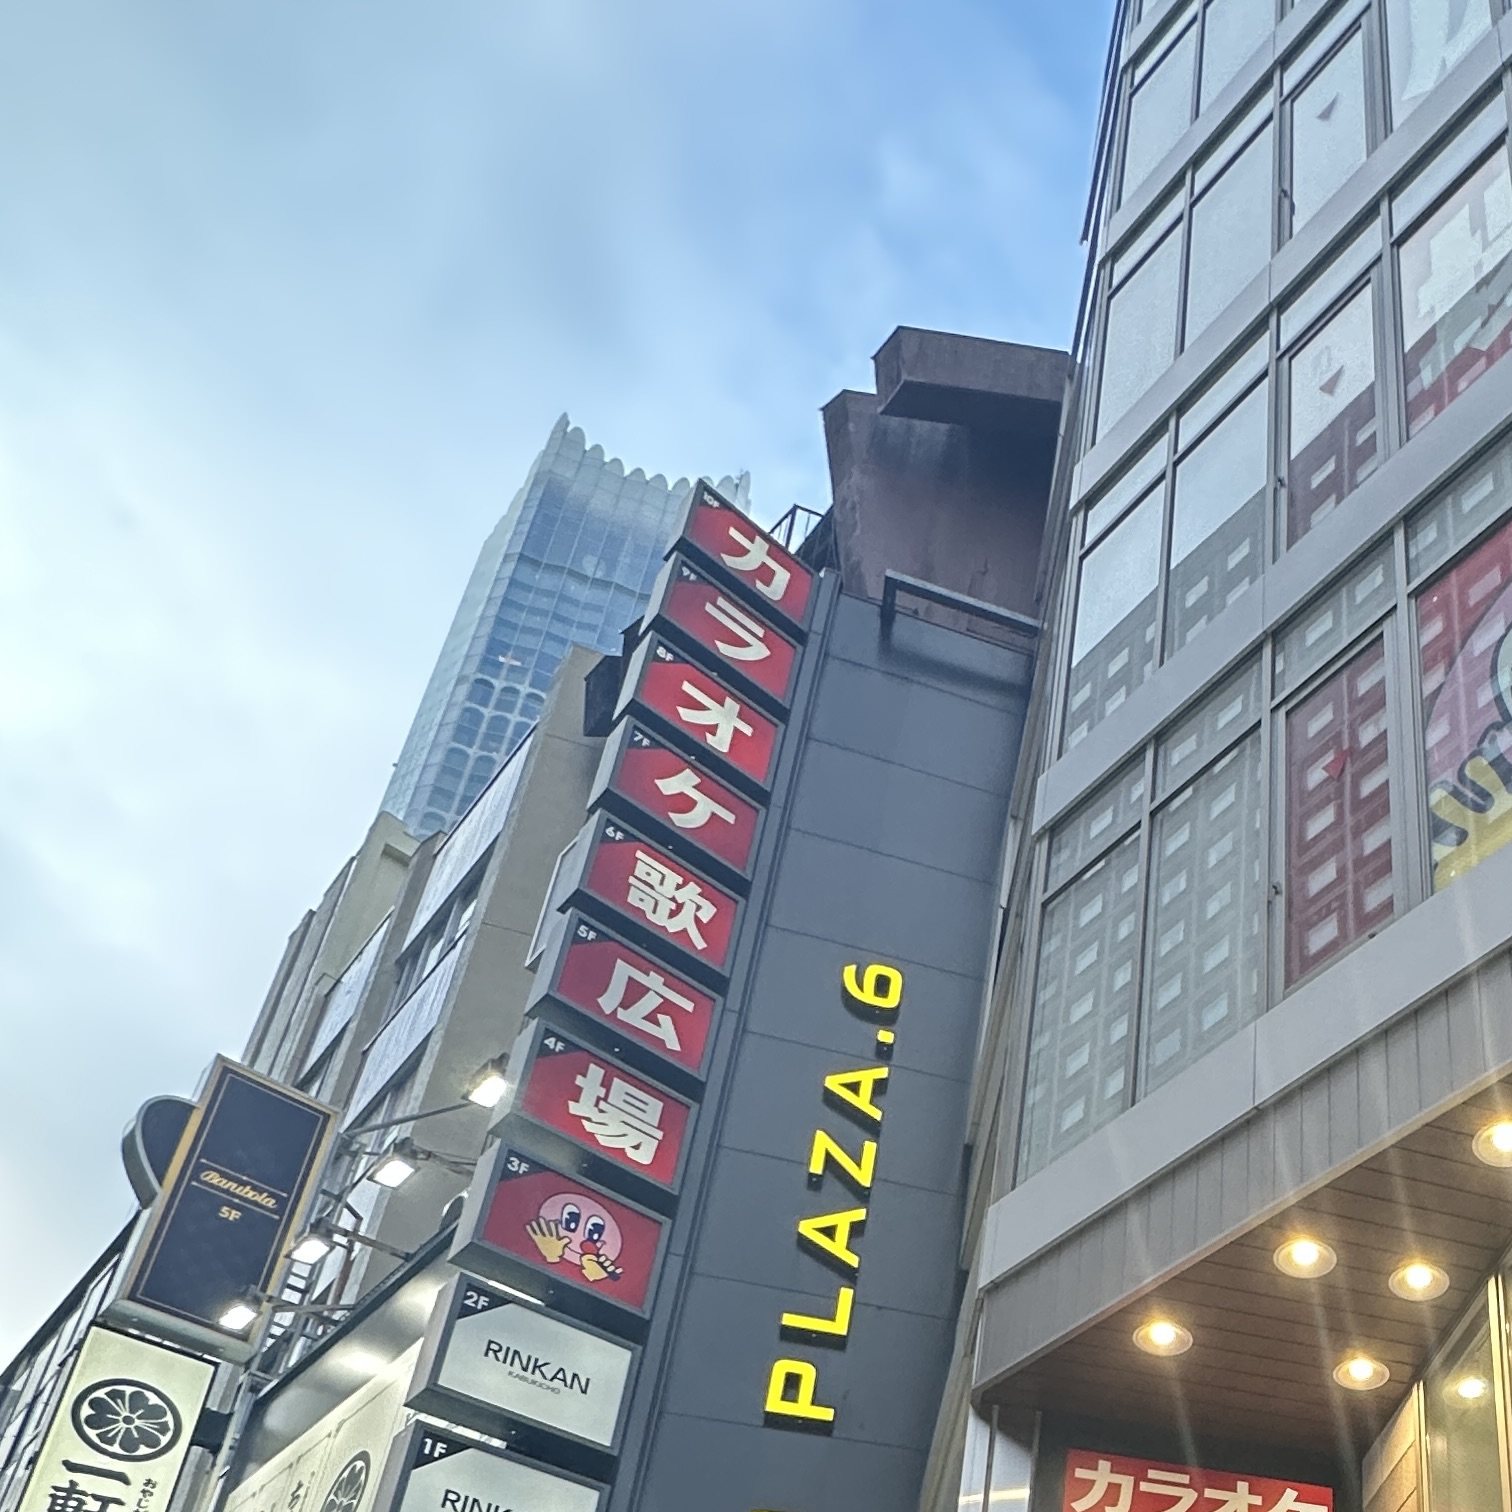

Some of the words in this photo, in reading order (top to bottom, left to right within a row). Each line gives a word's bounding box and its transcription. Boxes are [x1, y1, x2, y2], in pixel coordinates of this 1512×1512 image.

[633, 730, 651, 747] 7F
[605, 826, 625, 842] 6F
[577, 924, 598, 941] 5F
[543, 1036, 566, 1053] 4F
[506, 1157, 530, 1174] 3F
[218, 1206, 242, 1222] 5F
[463, 1290, 490, 1311] 2F
[483, 1339, 591, 1395] RINKAN
[507, 1370, 562, 1395] KABUKICHO
[421, 1437, 448, 1459] 1F
